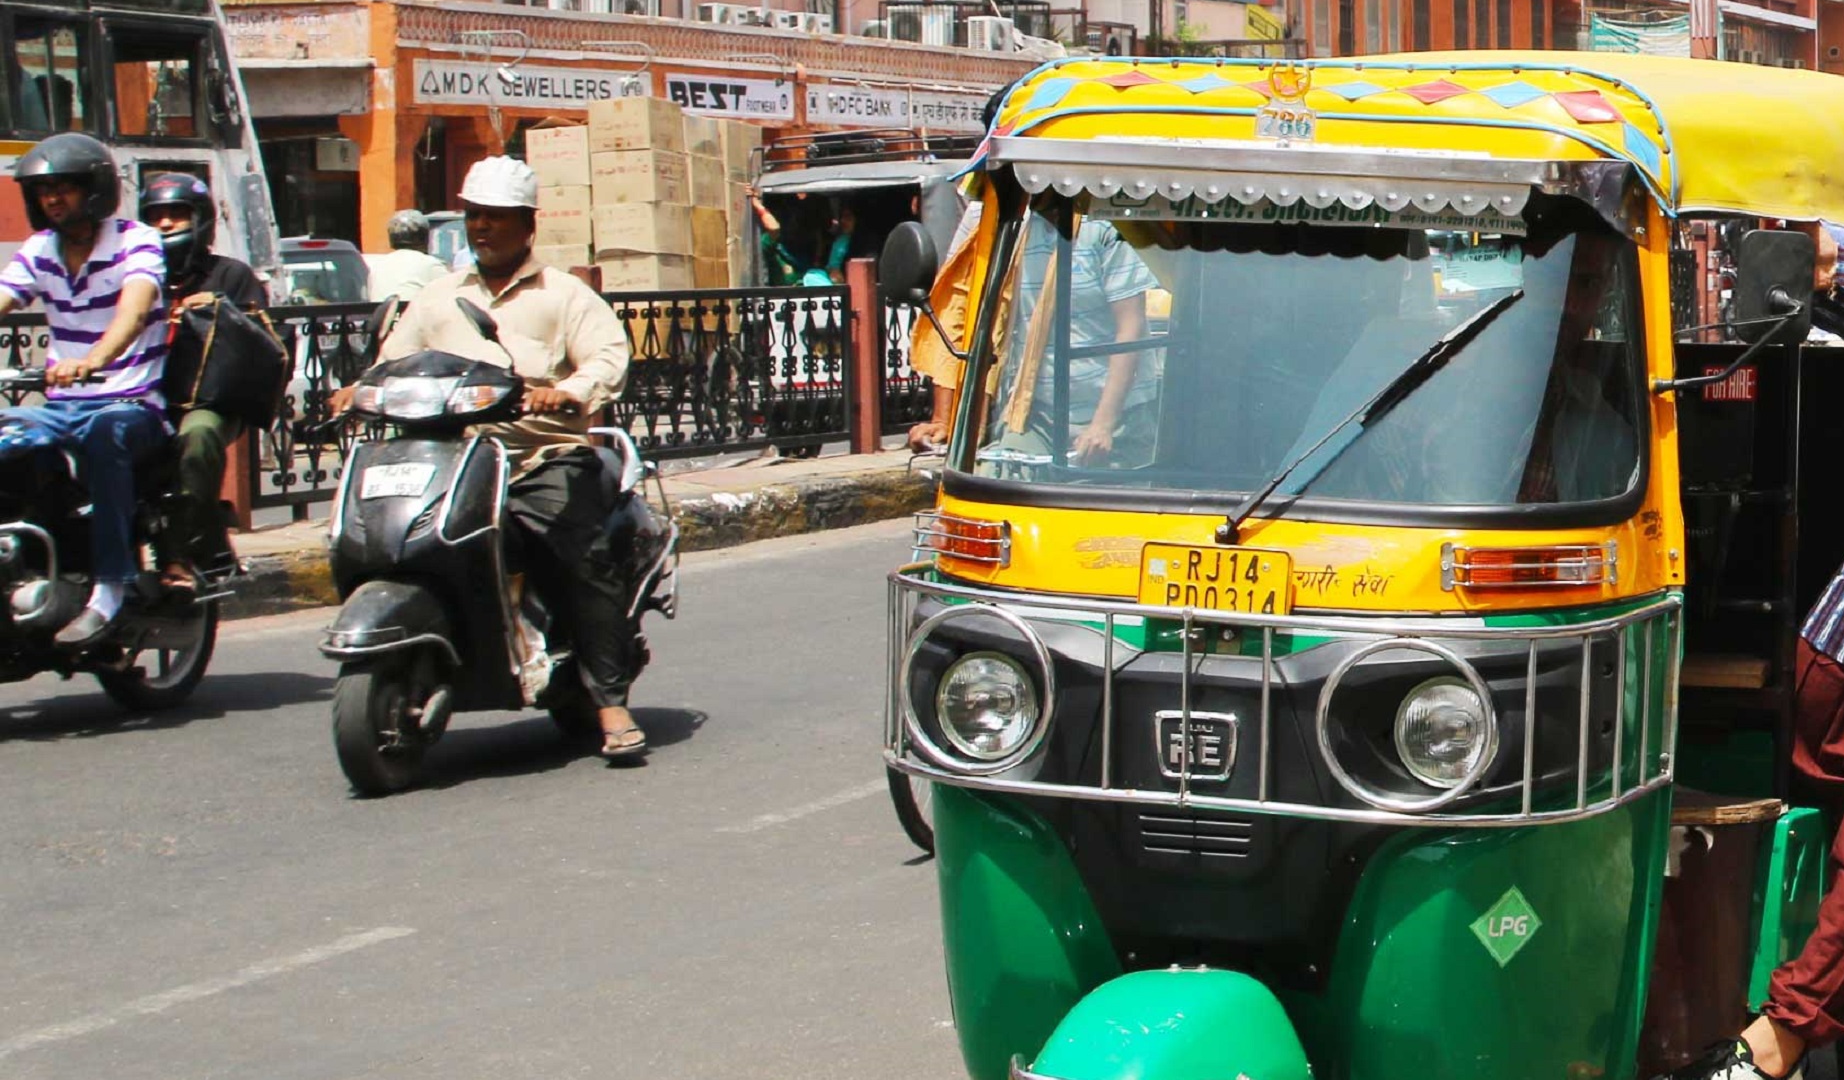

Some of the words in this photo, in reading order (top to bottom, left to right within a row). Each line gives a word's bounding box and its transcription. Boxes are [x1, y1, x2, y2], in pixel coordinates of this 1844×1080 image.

[669, 80, 747, 111] BEST
[746, 98, 776, 113] FOOTWEAR
[829, 95, 862, 116] HDFC
[865, 95, 892, 117] BANK
[1705, 369, 1727, 399] FOR
[1729, 369, 1753, 399] HIRE
[1187, 549, 1261, 584] RJ14
[1170, 733, 1221, 766] RE
[1488, 915, 1529, 937] LPG
